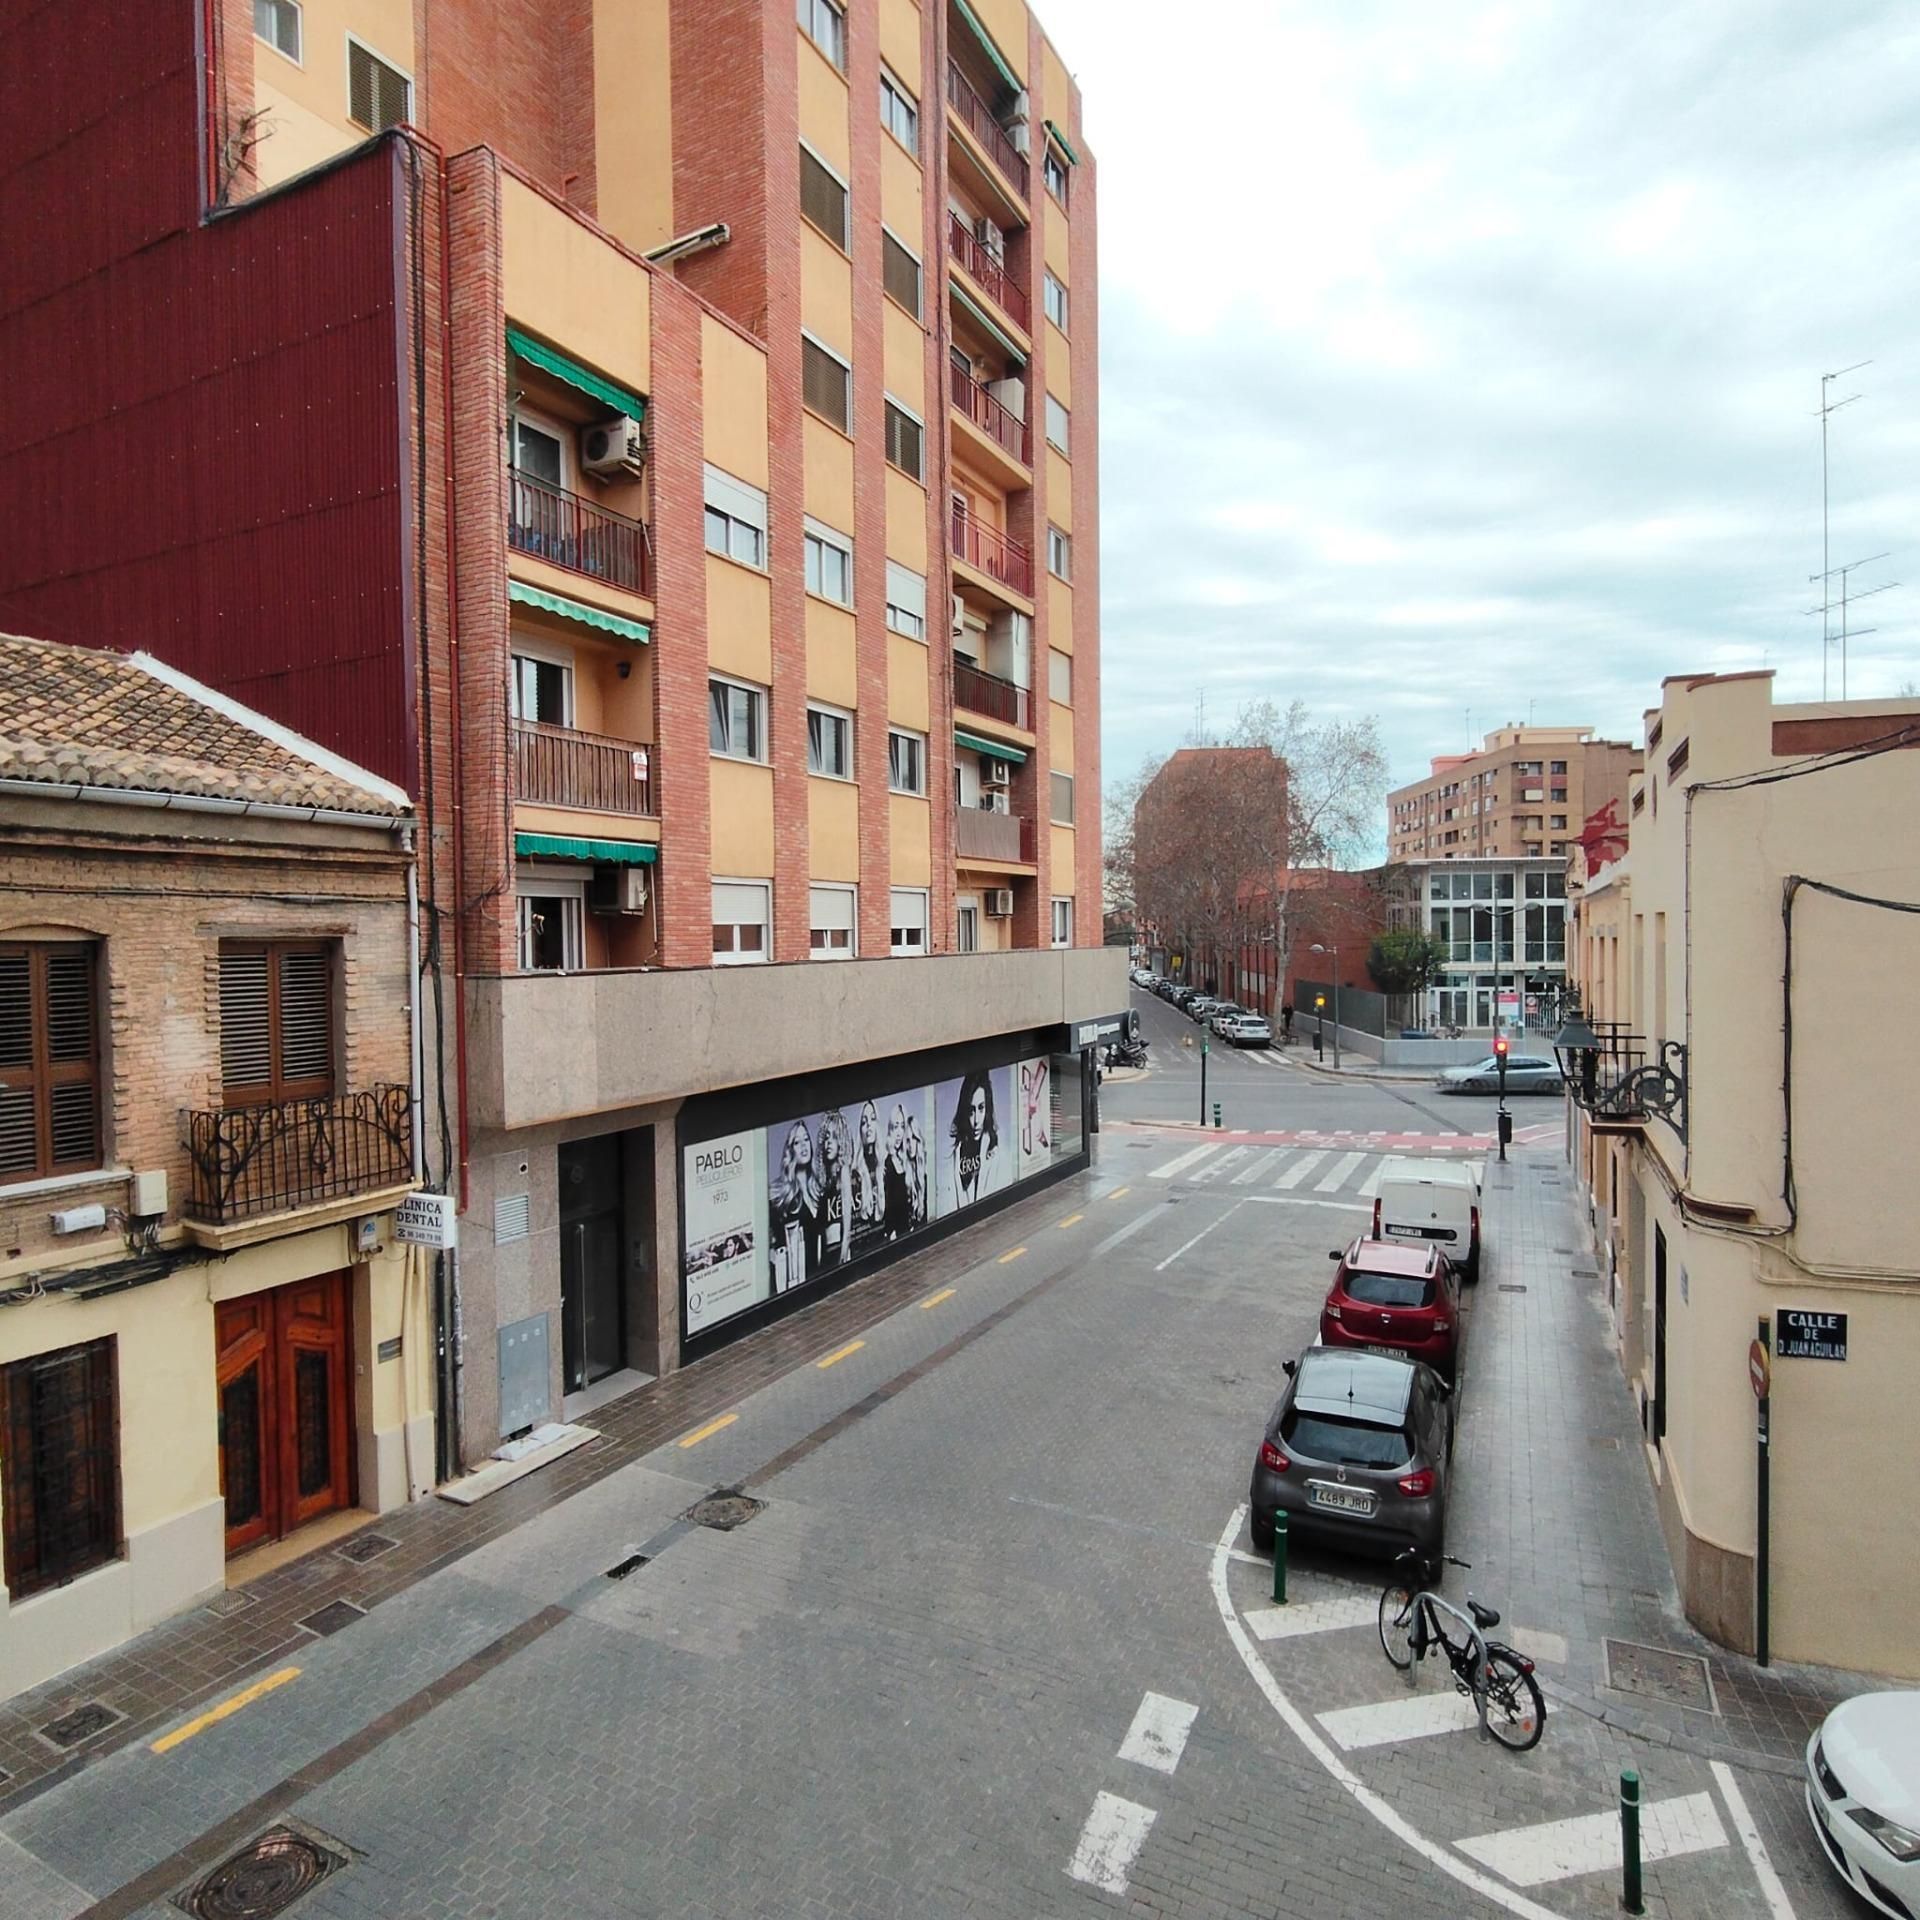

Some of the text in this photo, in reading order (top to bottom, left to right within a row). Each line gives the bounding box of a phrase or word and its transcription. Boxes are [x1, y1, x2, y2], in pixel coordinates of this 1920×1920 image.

[695, 1144, 743, 1174] PABLO
[712, 1190, 729, 1205] 1973
[396, 1211, 442, 1228] DENTAL
[1788, 1313, 1838, 1329] CALLE
[1804, 1328, 1819, 1340] DE
[1787, 1340, 1808, 1355] JUAN
[1809, 1342, 1846, 1358] AGUILAR
[1318, 1490, 1369, 1511] 4489 JRD
